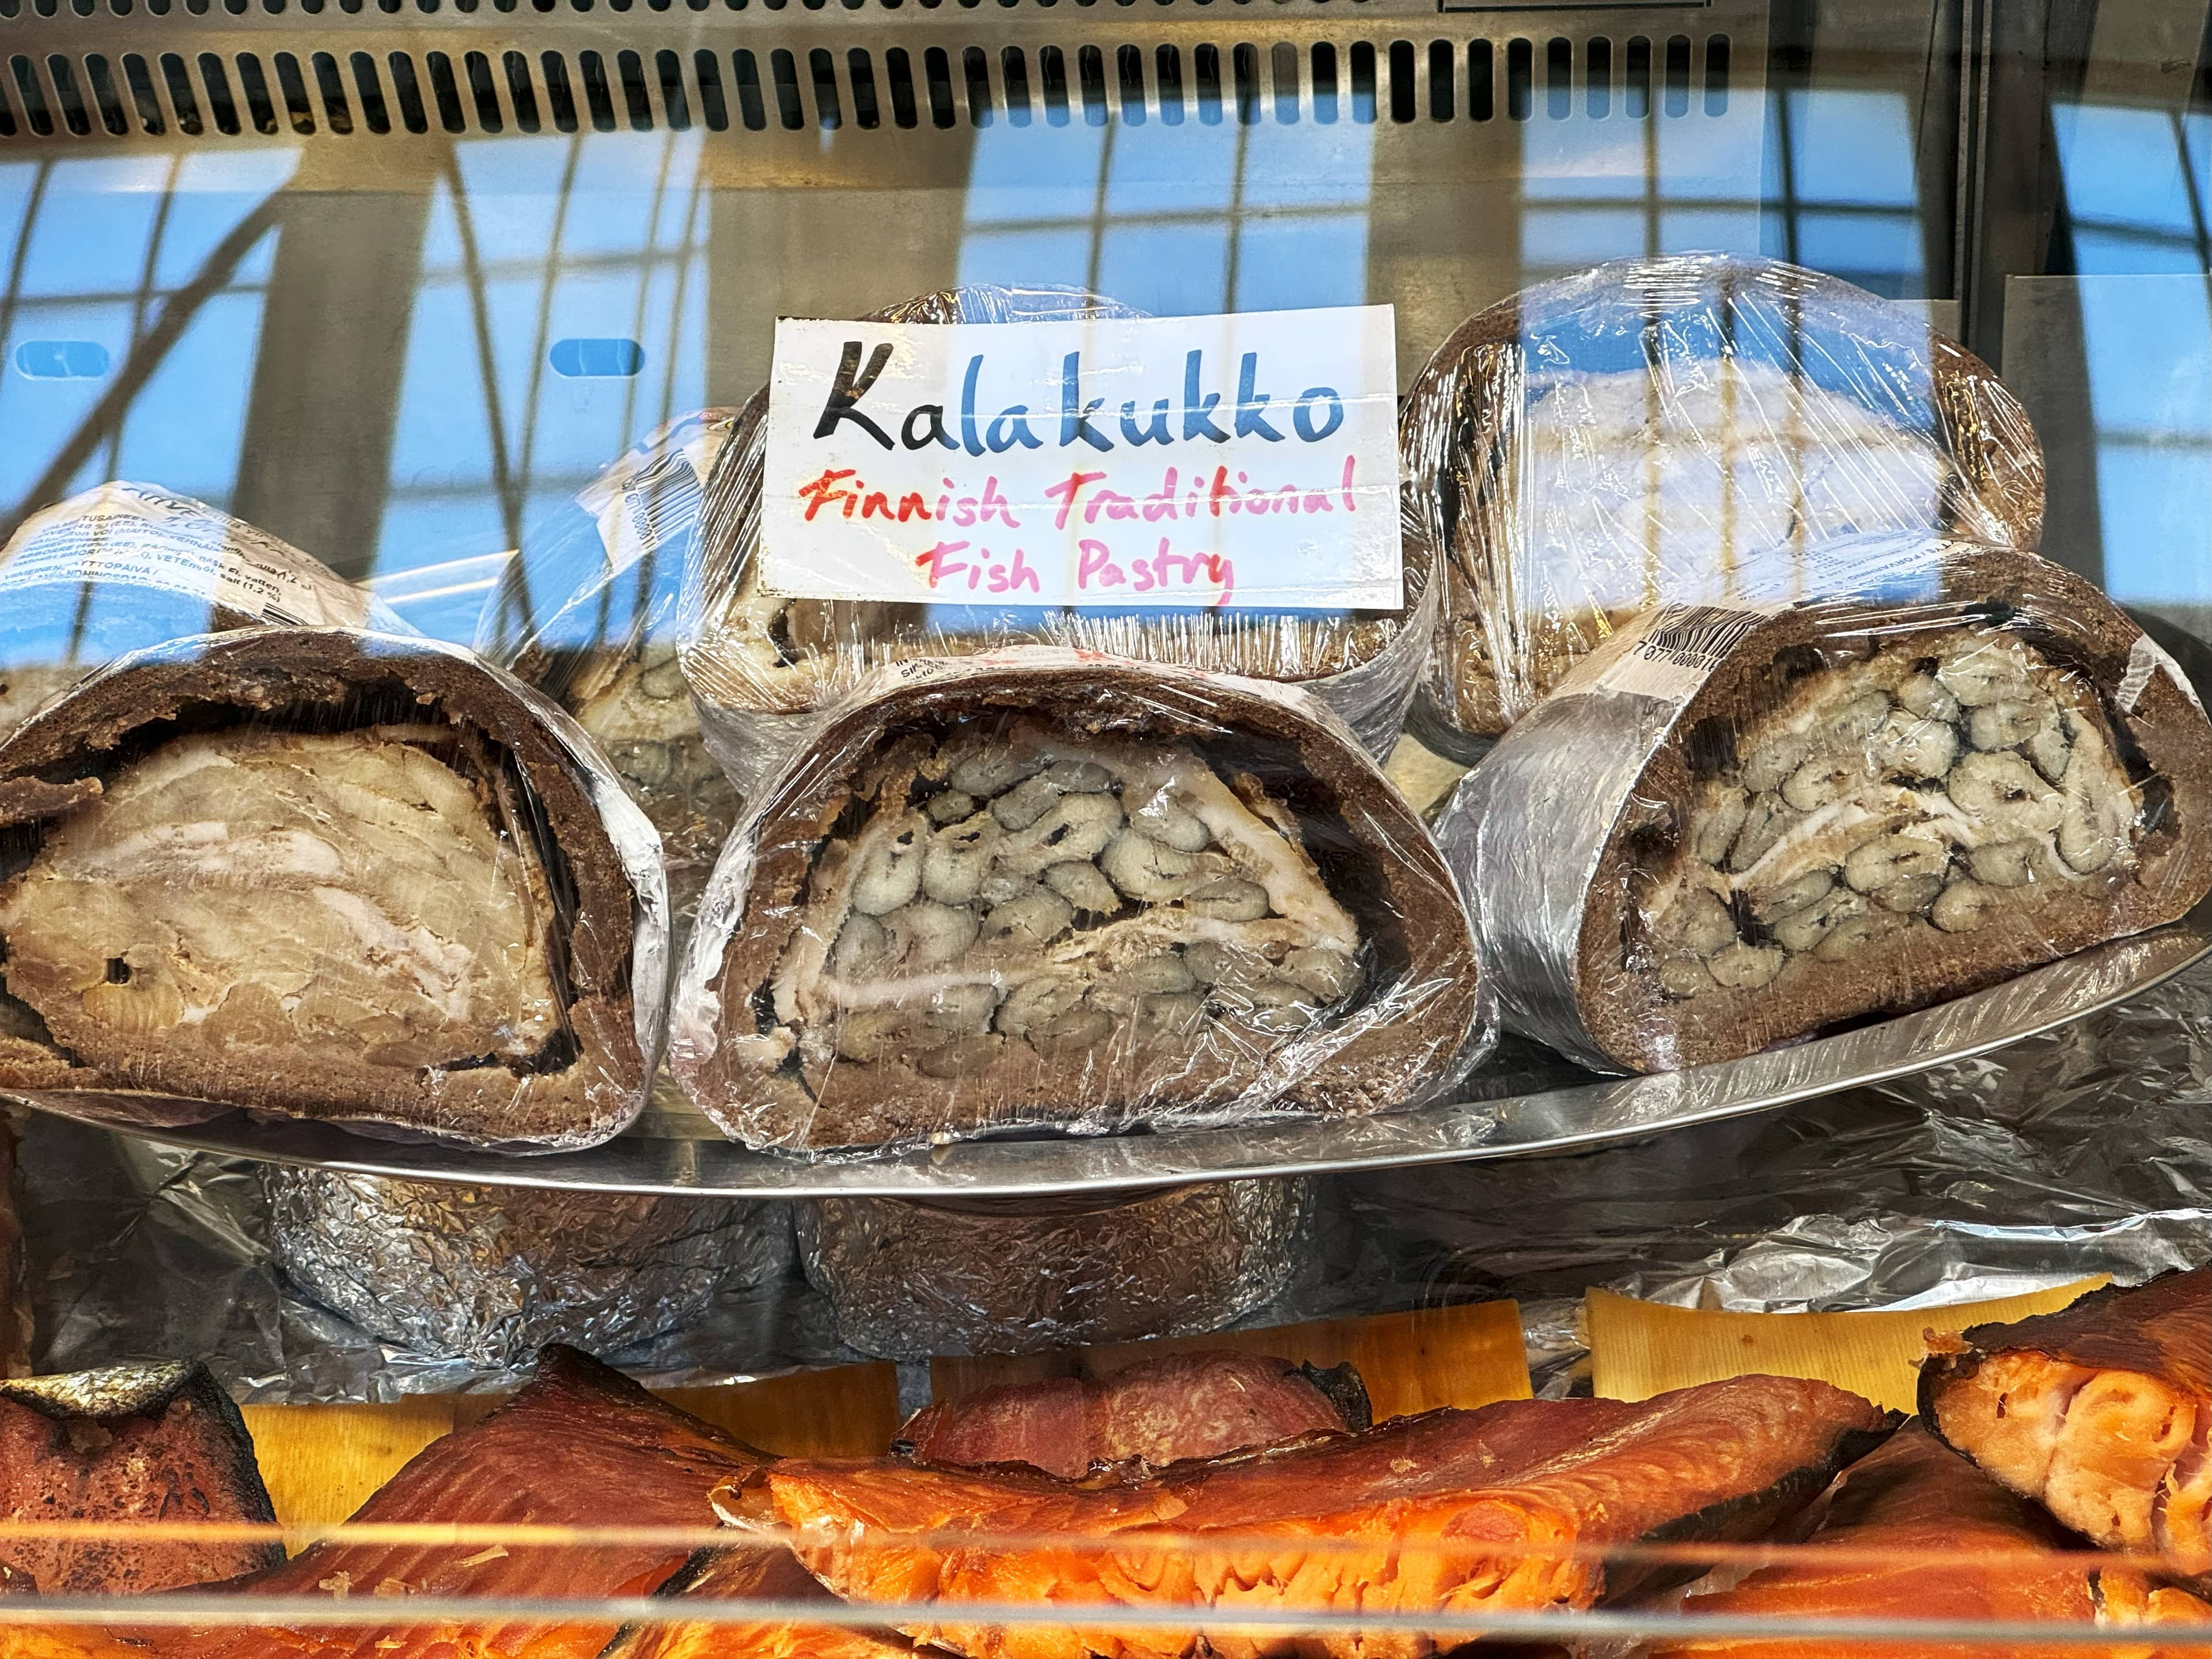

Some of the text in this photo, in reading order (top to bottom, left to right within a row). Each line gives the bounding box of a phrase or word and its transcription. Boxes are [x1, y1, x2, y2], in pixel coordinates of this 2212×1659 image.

[813, 341, 1344, 457] Kalakukko
[798, 455, 1356, 531] Finnish Traditional
[915, 537, 1234, 605] Fish Pastry
